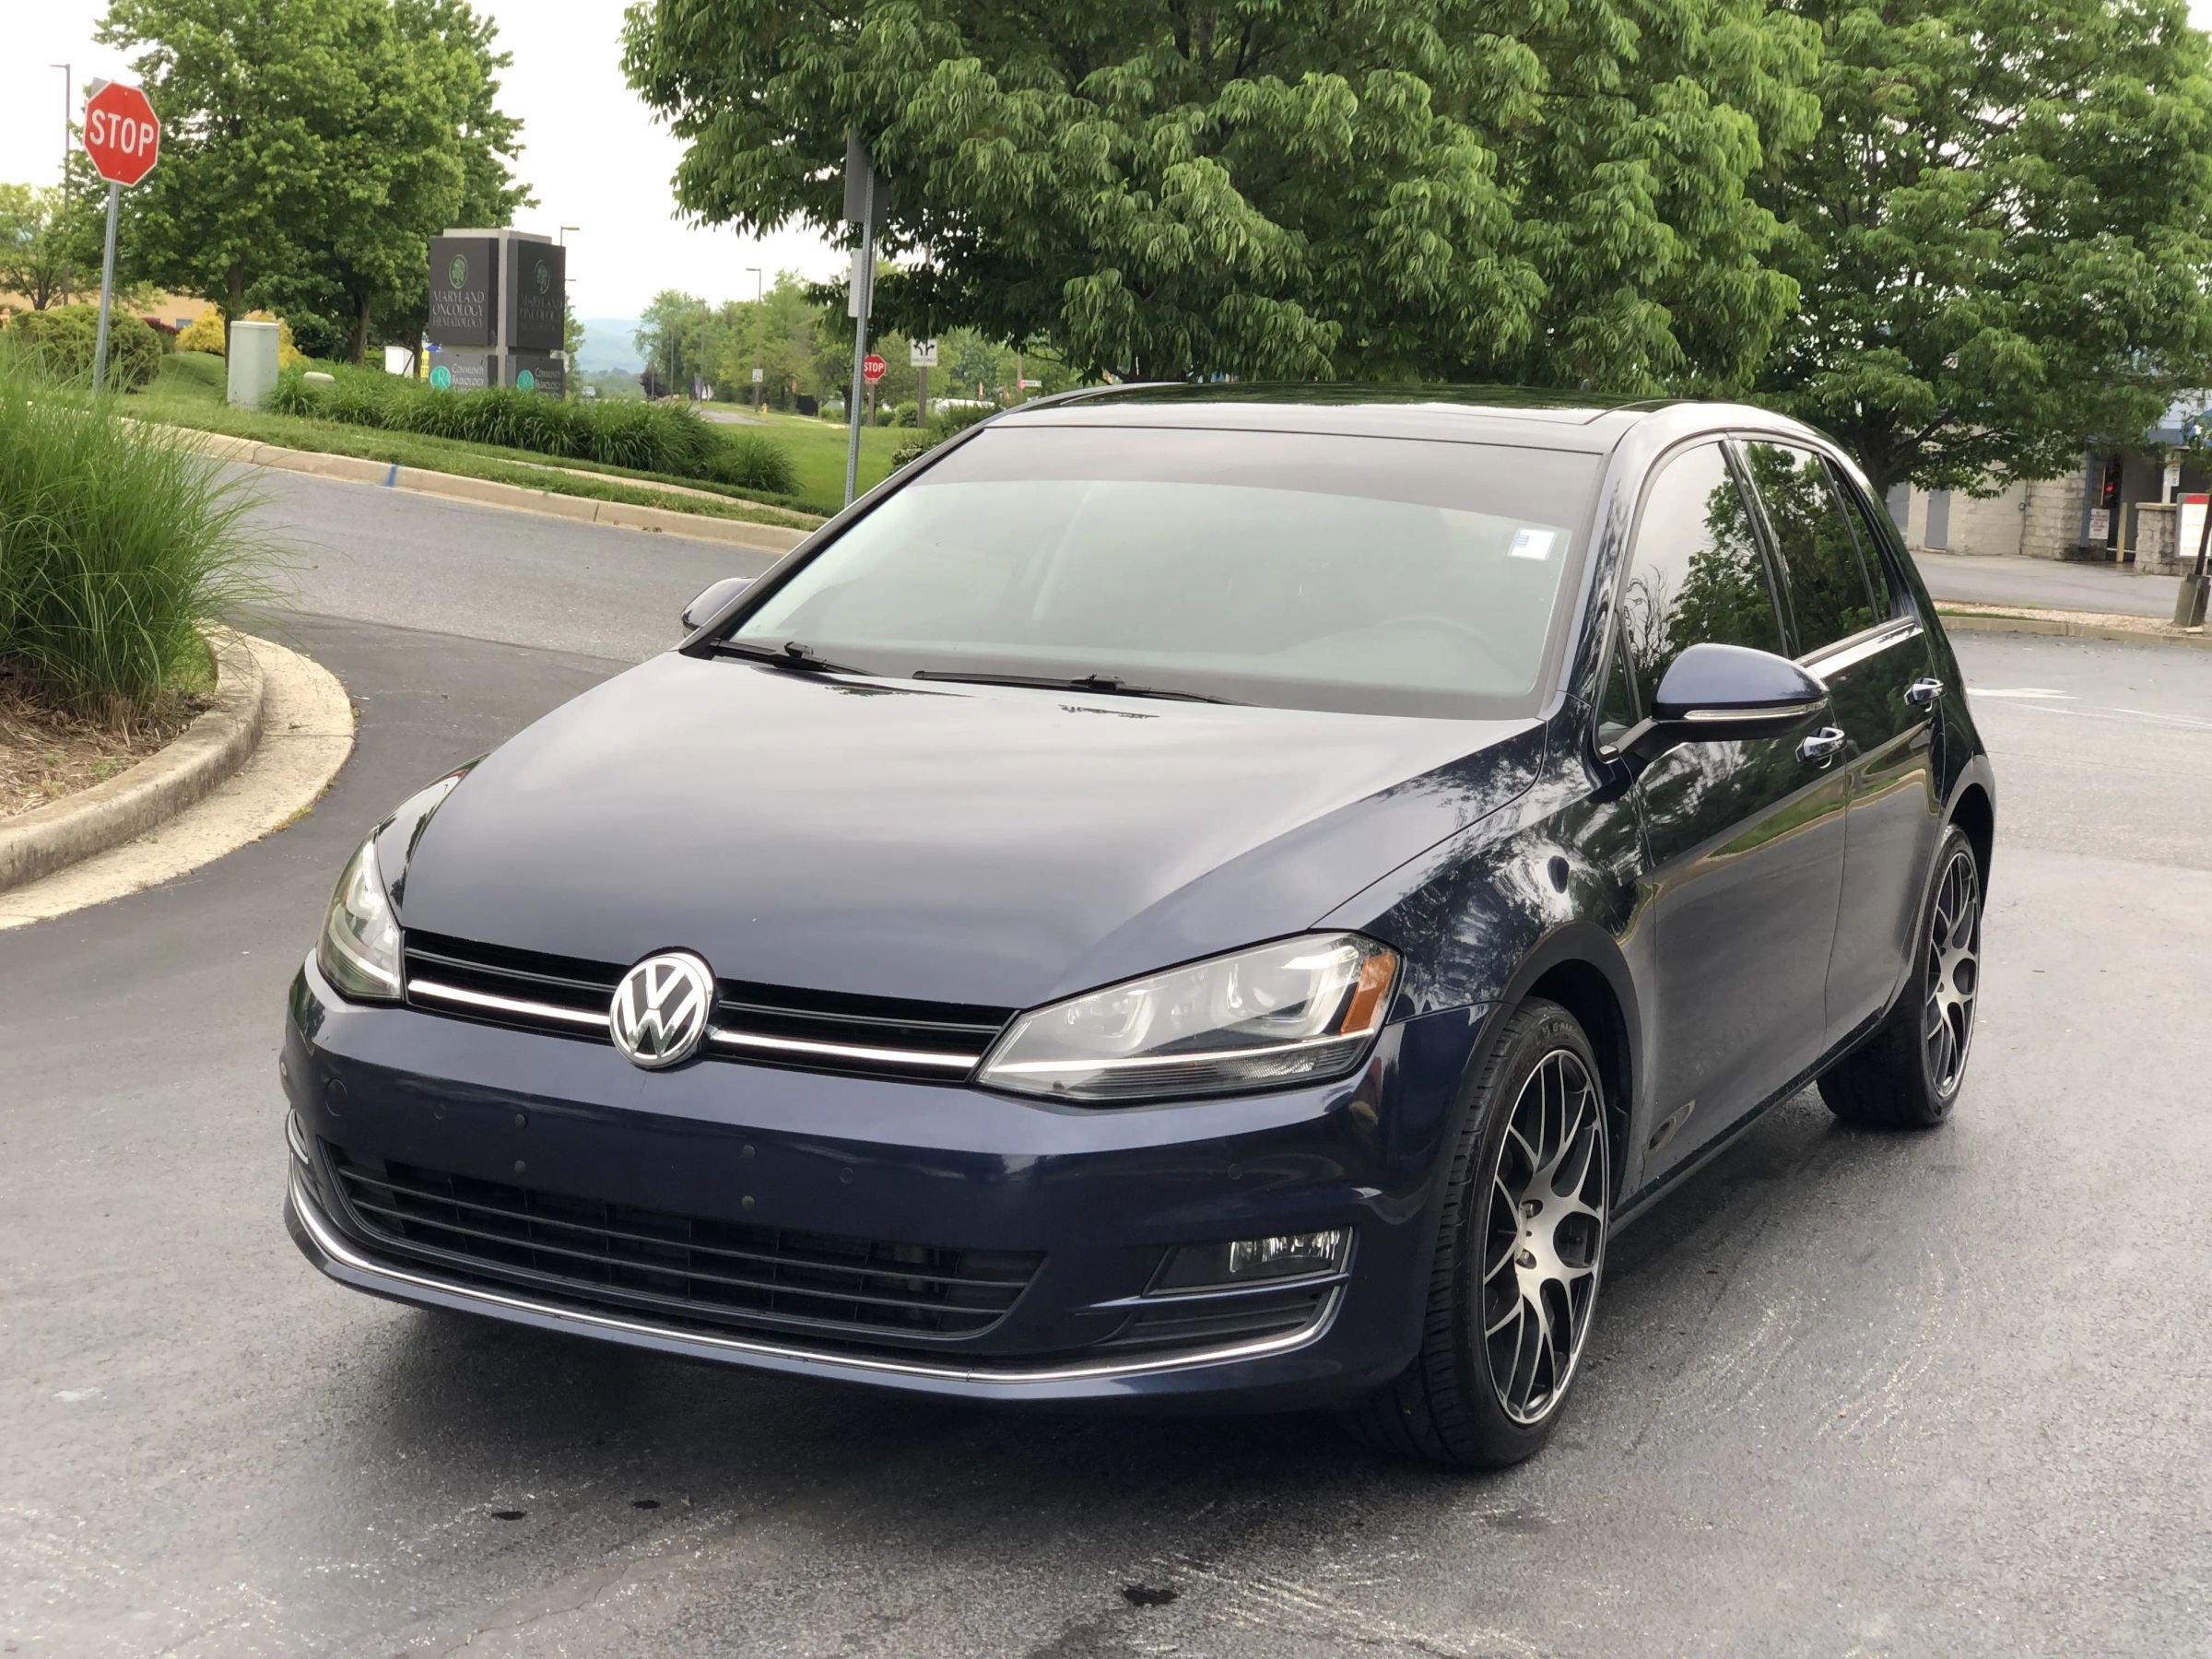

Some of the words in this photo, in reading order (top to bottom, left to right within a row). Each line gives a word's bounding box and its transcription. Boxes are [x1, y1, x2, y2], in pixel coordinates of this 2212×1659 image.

[89, 109, 154, 157] STOP
[433, 290, 485, 303] MARYLAND
[432, 303, 483, 317] ONCOLOGY
[432, 316, 483, 328] HEMATOLOGY
[864, 361, 884, 372] STOP
